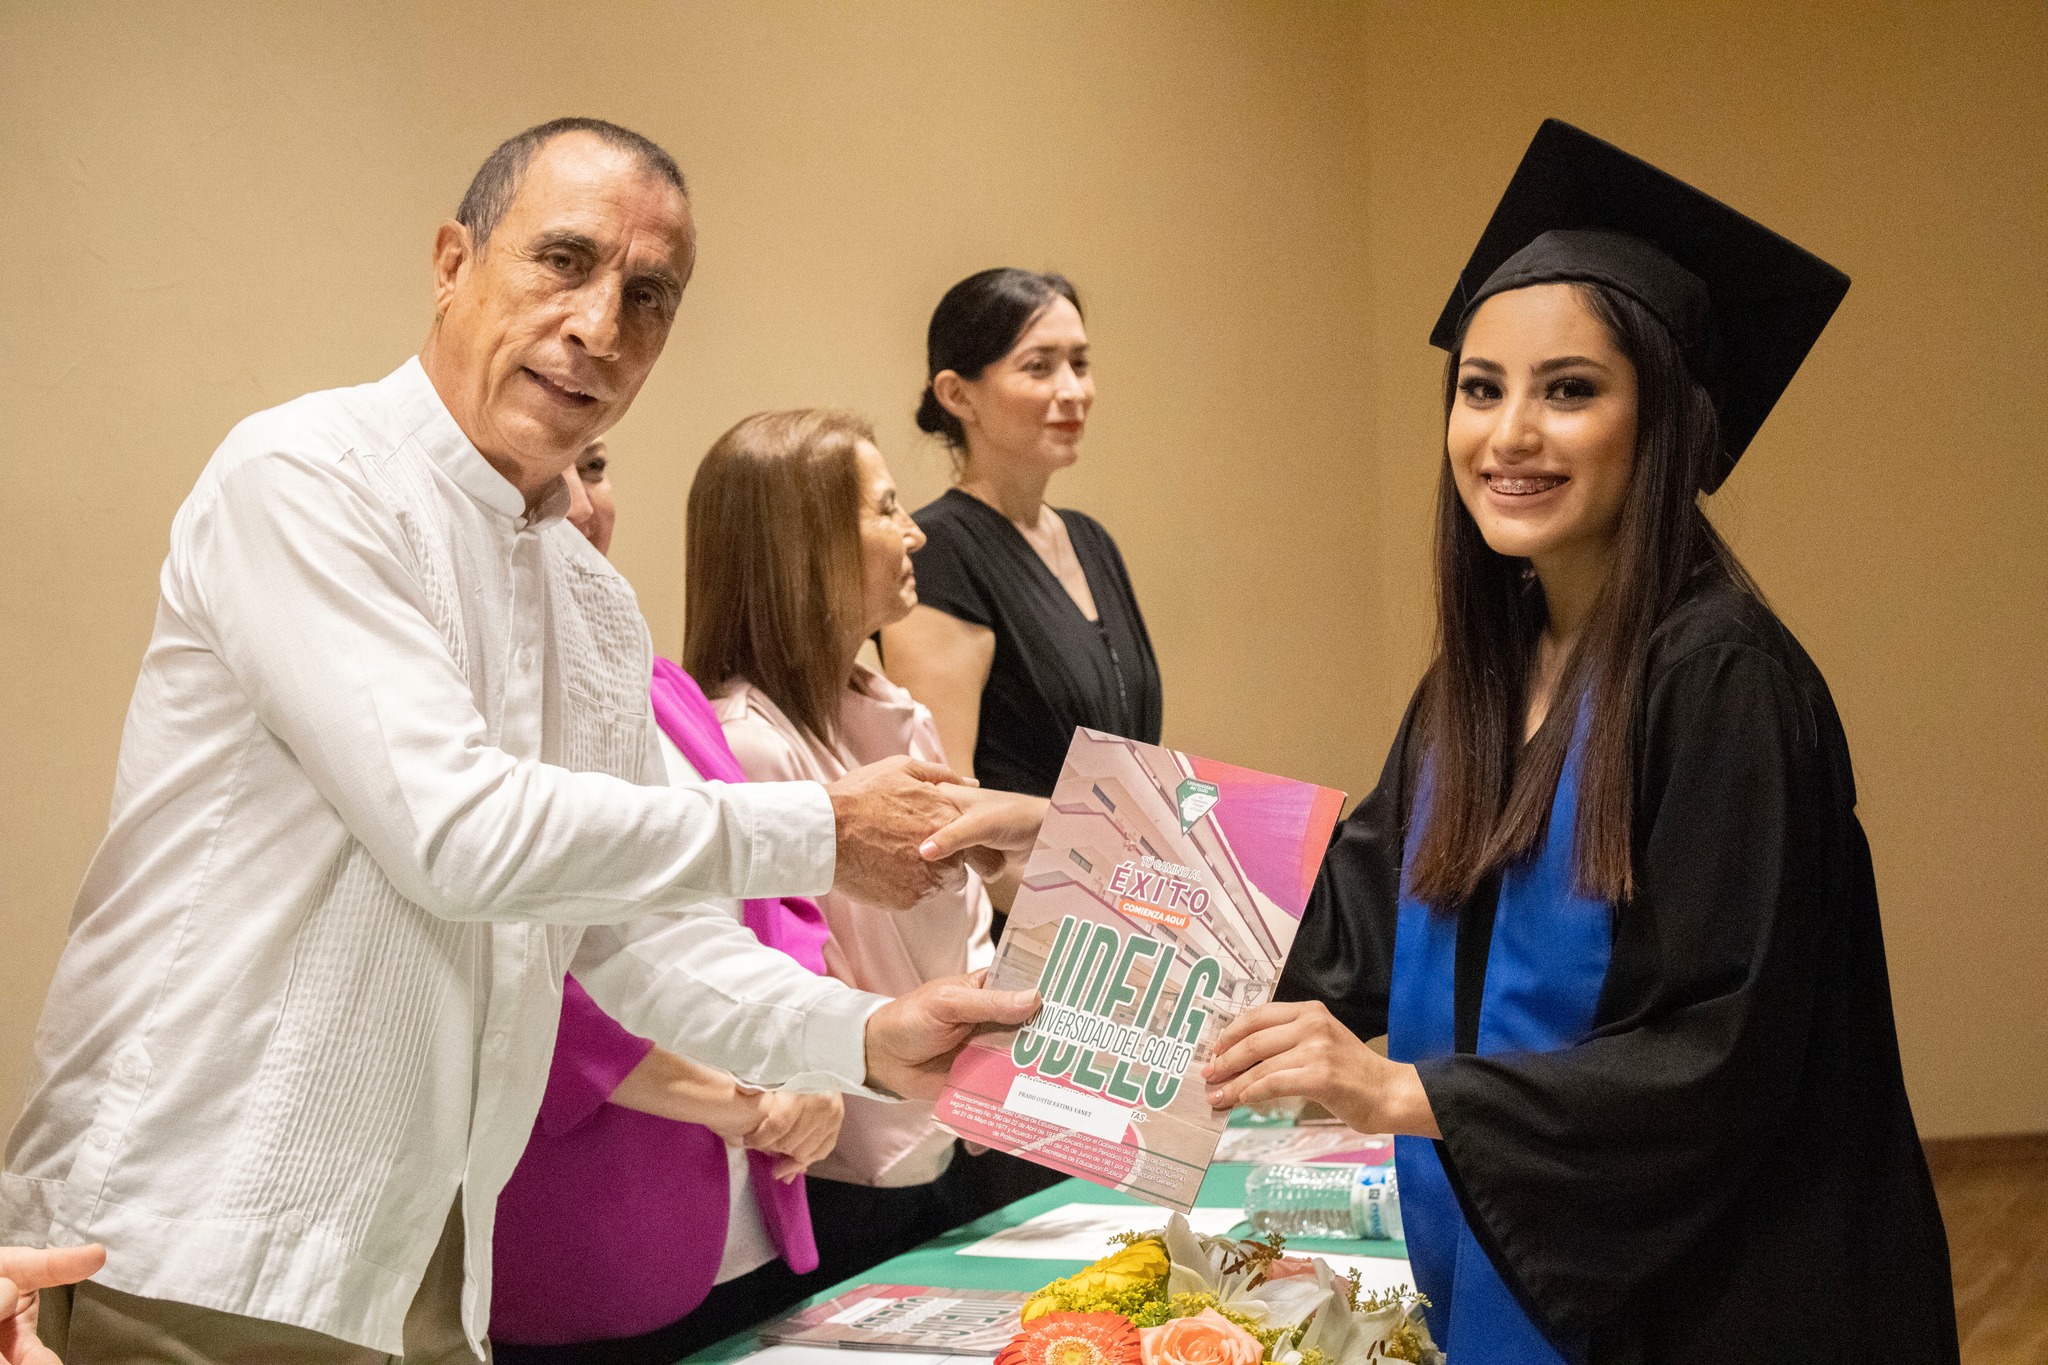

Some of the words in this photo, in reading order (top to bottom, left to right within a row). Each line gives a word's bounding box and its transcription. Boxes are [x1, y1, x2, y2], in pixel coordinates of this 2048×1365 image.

[1154, 860, 1190, 876] CAMINO
[1188, 869, 1202, 881] AL
[1108, 861, 1210, 916] ÉXITO
[1123, 902, 1165, 922] COMIENZA
[1164, 912, 1187, 927] AQUÍ
[1112, 1027, 1141, 1059] DEL
[1142, 1038, 1191, 1074] GOLFO
[1018, 1092, 1036, 1100] PRADO
[1074, 1109, 1092, 1117] YANET
[973, 1116, 988, 1125] Mayo
[1011, 1128, 1033, 1139] Acuerdo
[1078, 1151, 1092, 1160] Junio
